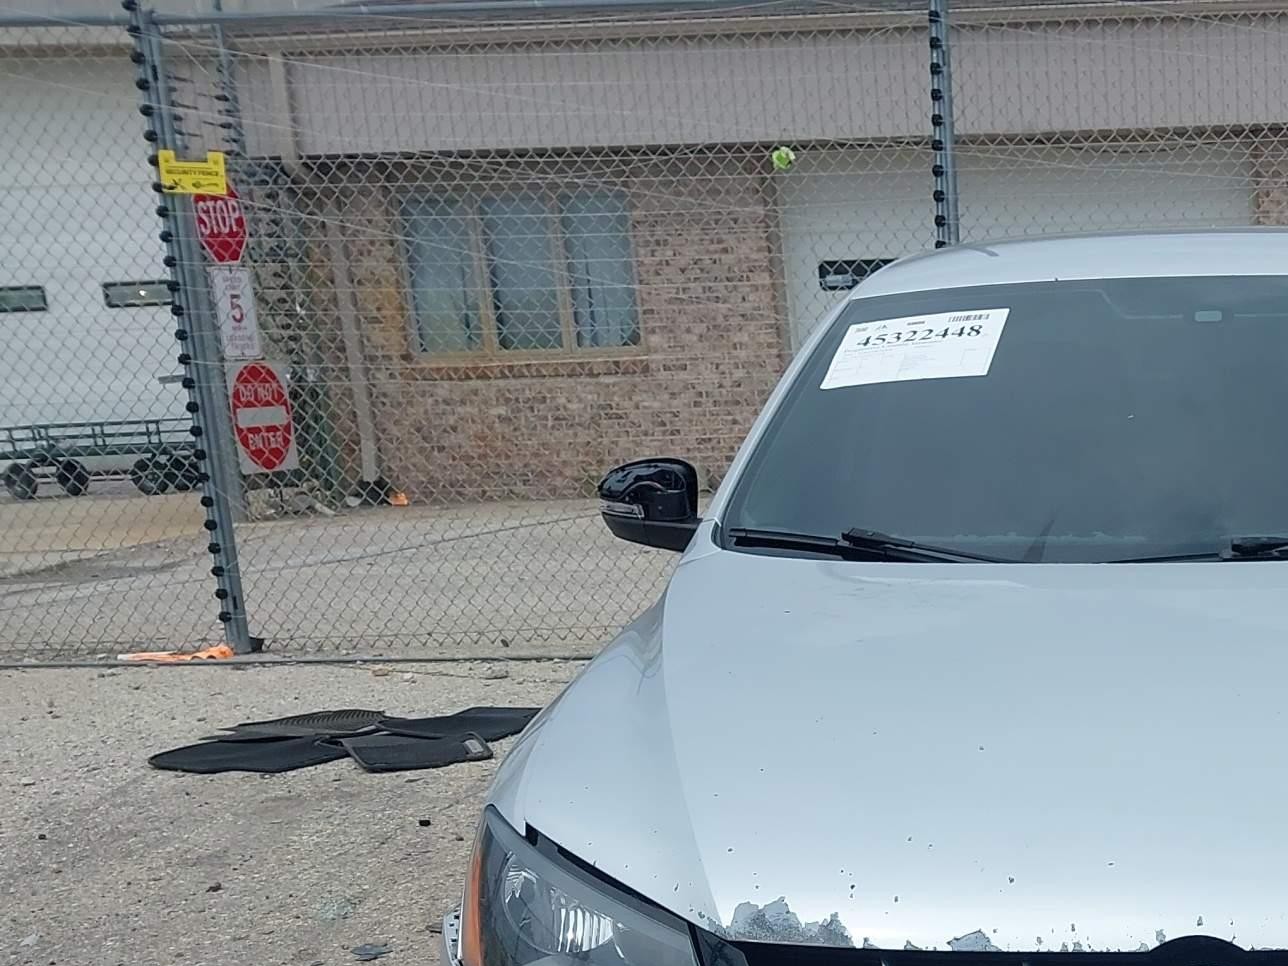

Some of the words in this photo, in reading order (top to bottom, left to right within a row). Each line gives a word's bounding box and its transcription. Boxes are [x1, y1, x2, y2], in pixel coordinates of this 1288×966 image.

[198, 200, 240, 234] STOP
[230, 294, 244, 323] 5
[856, 324, 983, 347] 45322448
[240, 383, 254, 401] DO
[257, 383, 279, 401] NOT
[248, 431, 284, 449] ENTER
